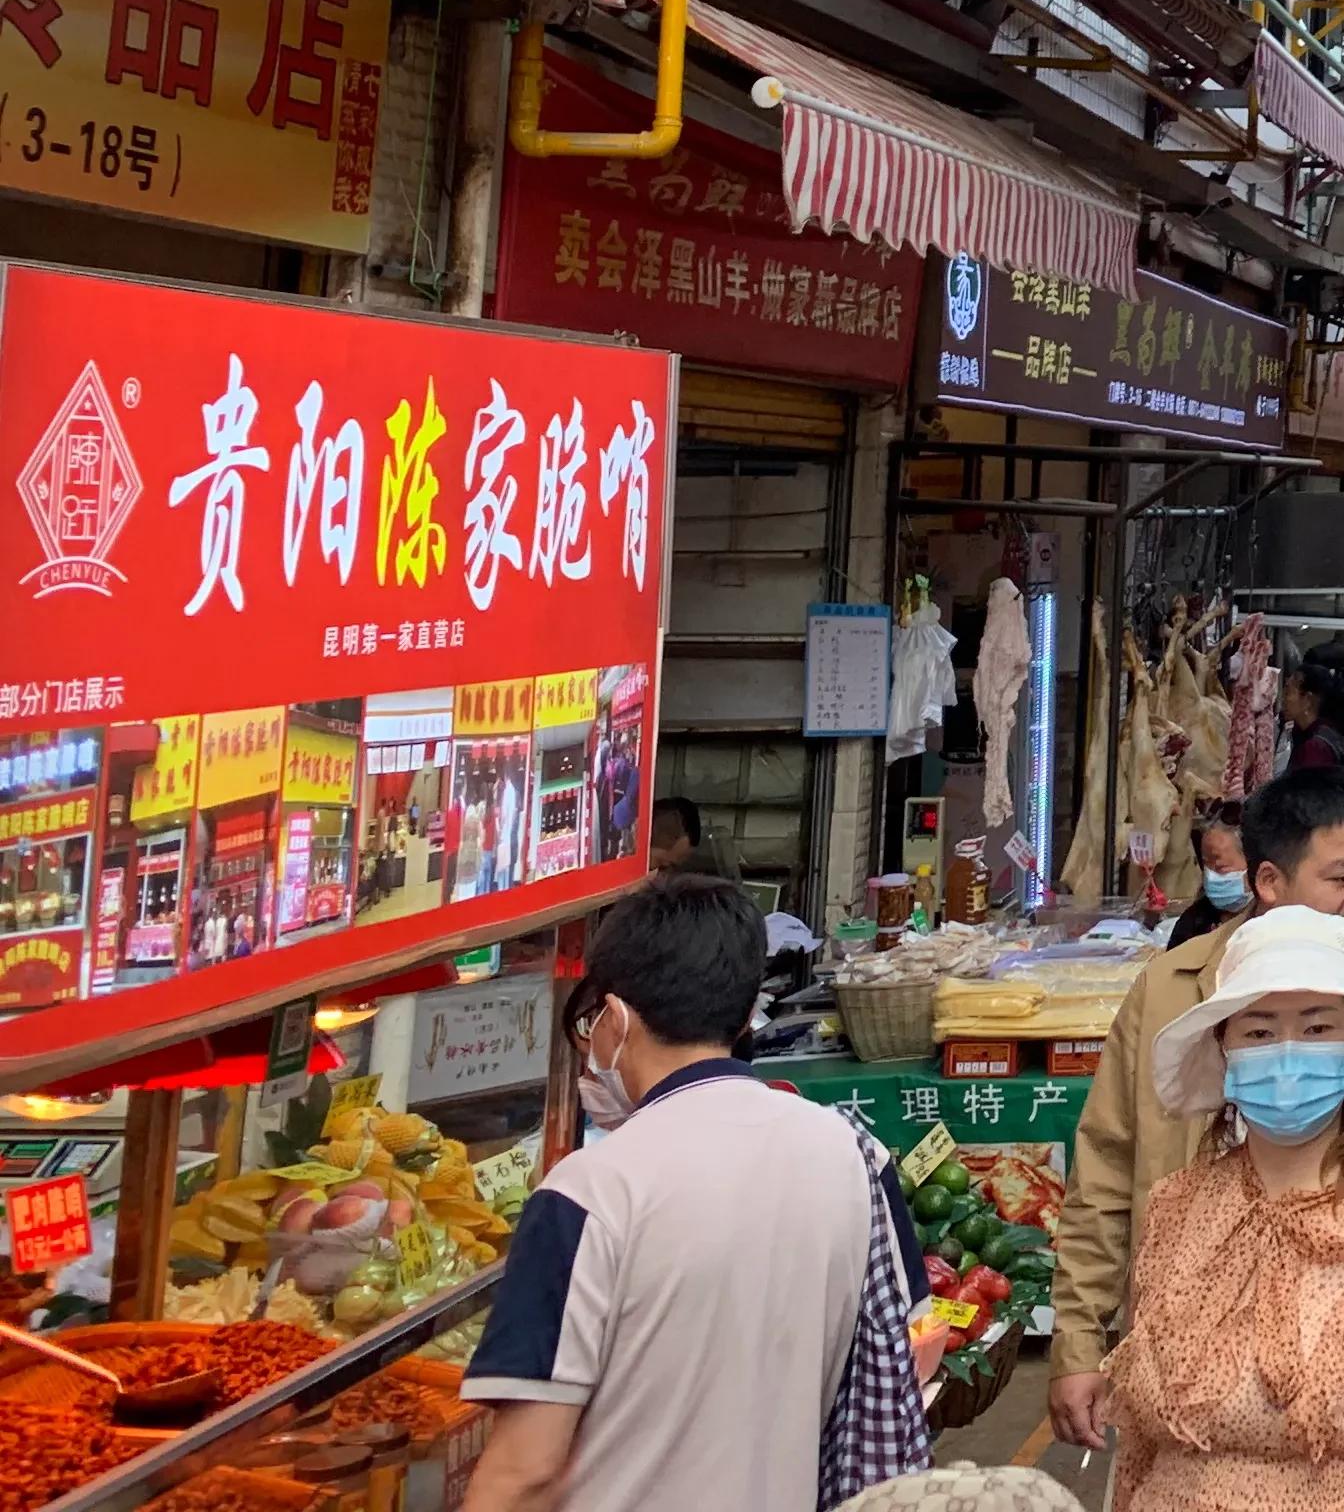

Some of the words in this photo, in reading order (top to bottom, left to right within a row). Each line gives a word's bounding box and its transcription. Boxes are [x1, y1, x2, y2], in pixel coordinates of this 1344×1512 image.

[168, 352, 657, 617] 贵阳陈家脆哨
[38, 564, 112, 589] CHENYUE
[321, 618, 466, 659] 昆明第一家直营店
[0, 676, 125, 720] 部分门店展示
[836, 1080, 1069, 1126] 大理特产
